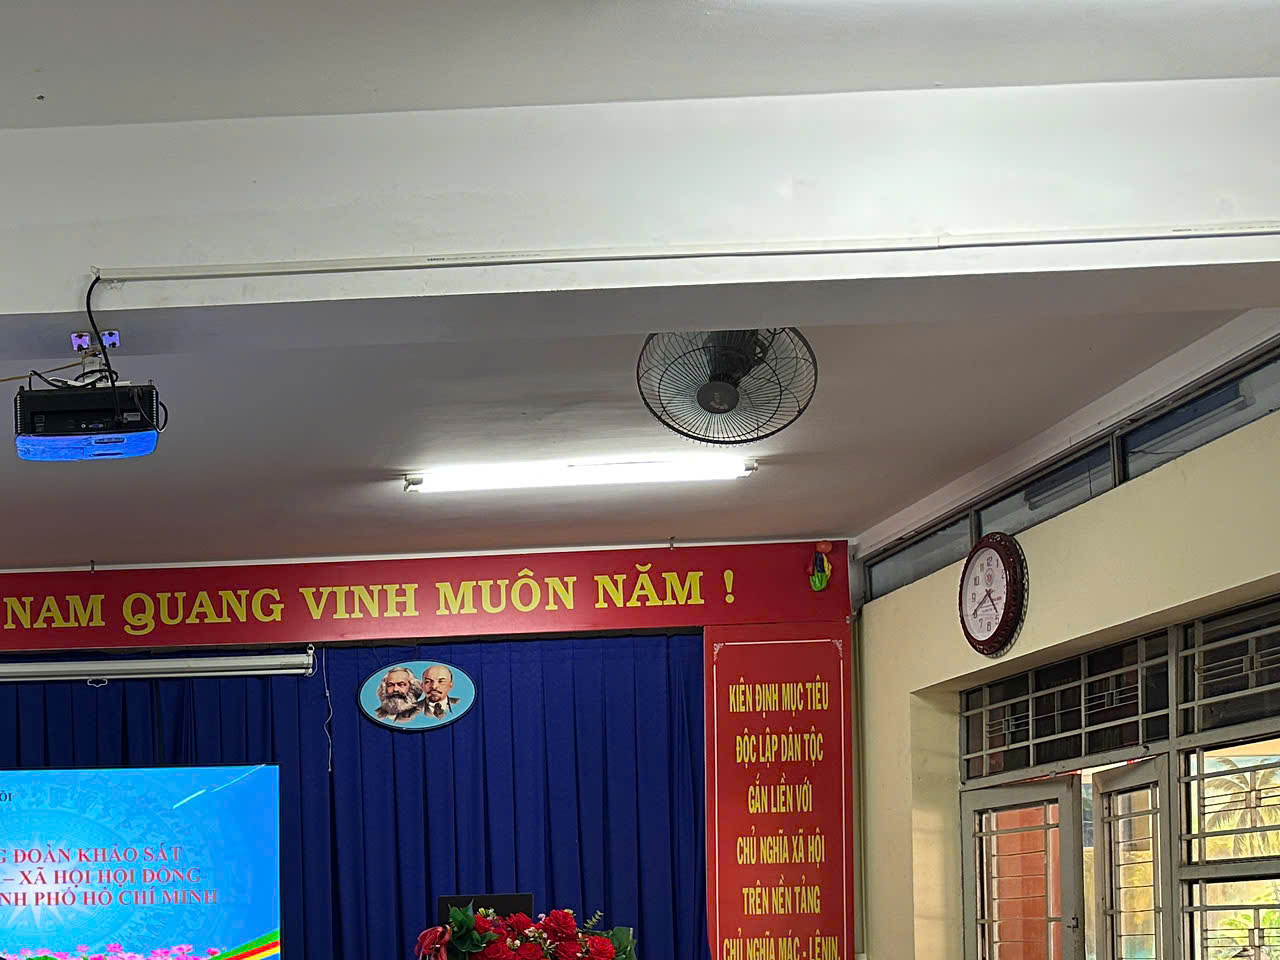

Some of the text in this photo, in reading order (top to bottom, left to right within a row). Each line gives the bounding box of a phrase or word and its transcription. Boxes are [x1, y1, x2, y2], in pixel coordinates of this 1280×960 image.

[4, 593, 106, 631] NAM
[121, 588, 287, 636] QUANG
[297, 582, 419, 621] VINH
[435, 568, 578, 615] MUÔN
[594, 561, 704, 609] NĂM
[723, 570, 735, 604] !
[728, 674, 829, 718] KIÊN ĐỊNH MỤC TIÊU
[736, 726, 824, 769] ĐỘC LẬP DÂN TỘC
[748, 772, 812, 815] GẮN LIỀN VỚI
[14, 844, 70, 864] ĐOÀN
[78, 843, 138, 863] KHẢO
[143, 842, 183, 862] SÁT
[736, 825, 825, 870] CHỦ NGHĨA XÃ HỘI
[20, 866, 46, 885] XÃ
[54, 868, 90, 888] HỘI
[98, 868, 134, 887] HỘI
[34, 886, 76, 906] PHỐ
[118, 886, 156, 906] CHÍ
[162, 888, 217, 904] MINH
[742, 874, 820, 915] TRÊN NỀN TẢNG
